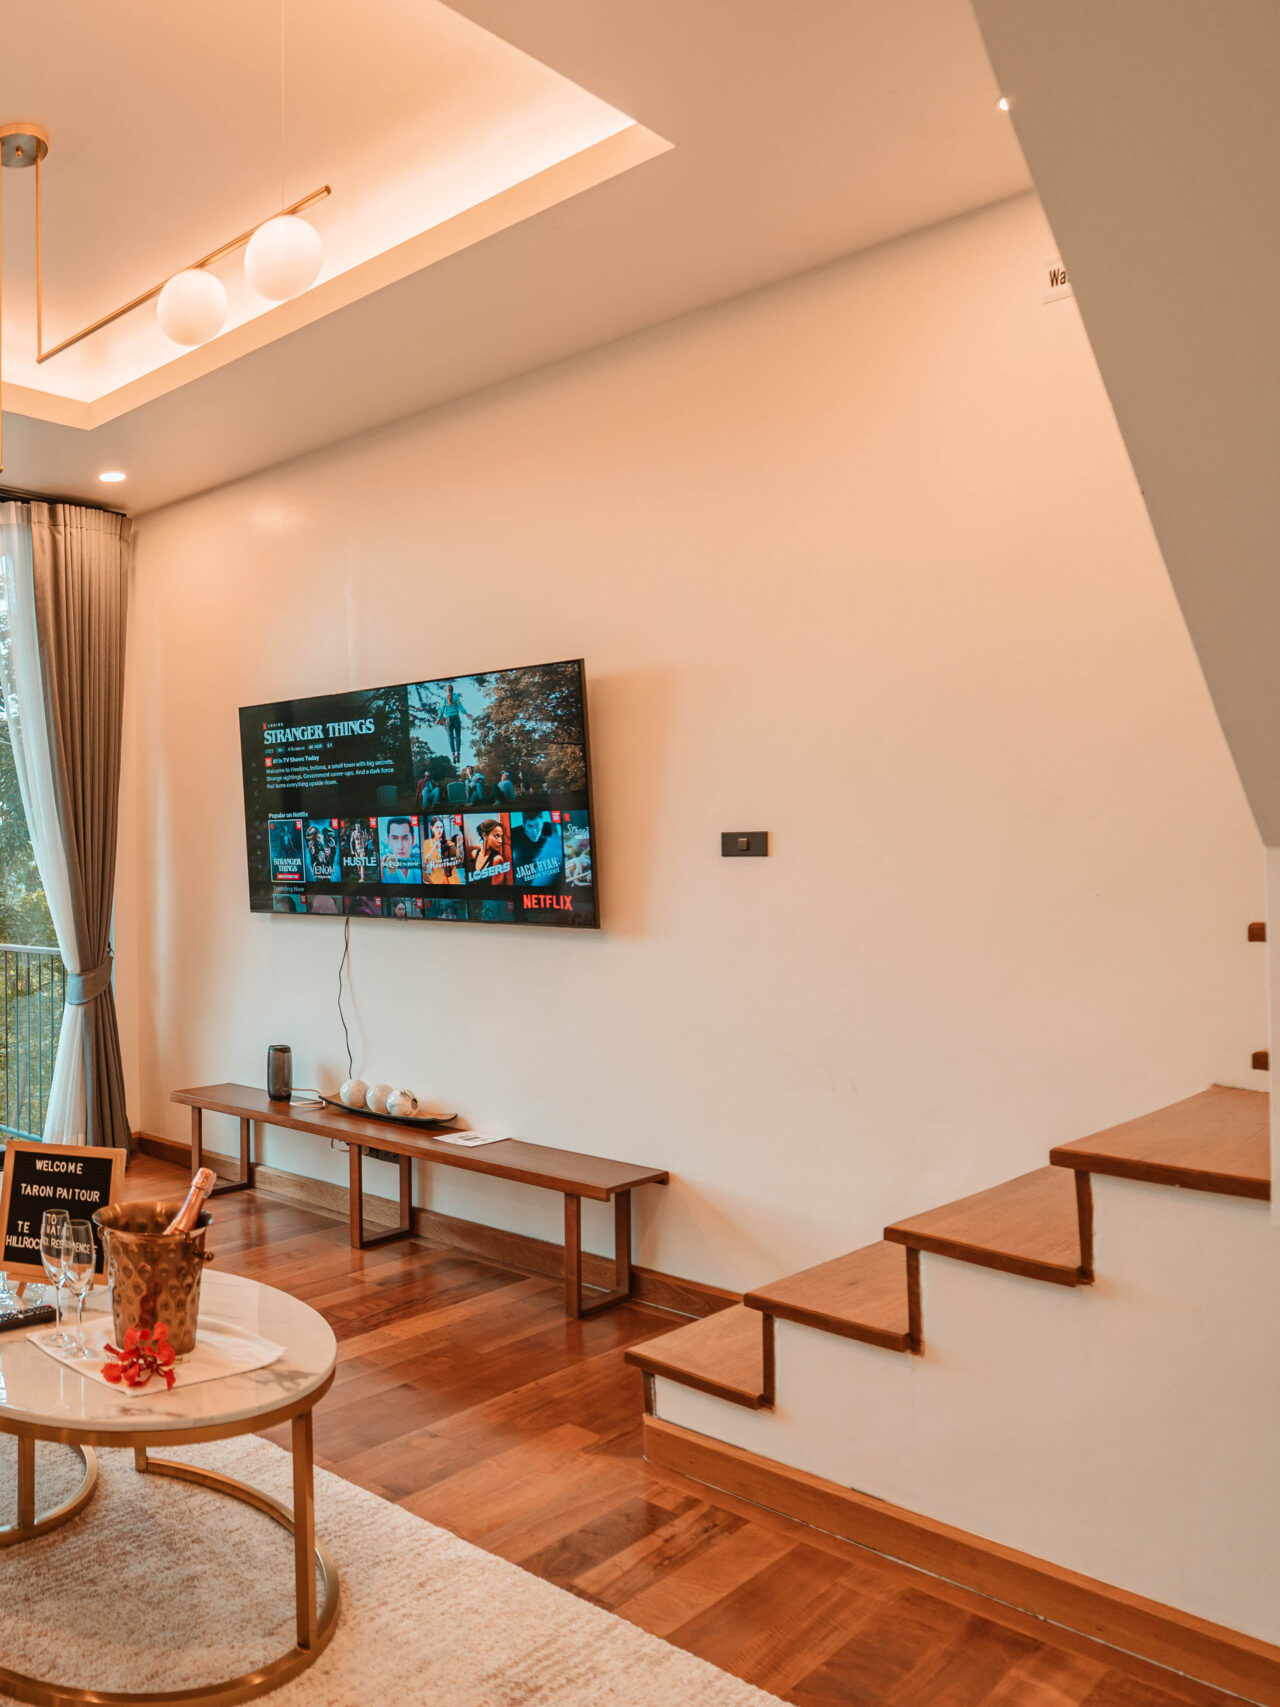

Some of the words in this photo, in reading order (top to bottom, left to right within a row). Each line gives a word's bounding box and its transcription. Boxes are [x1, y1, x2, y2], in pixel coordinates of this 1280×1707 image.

[264, 725, 324, 745] STRANGER
[327, 718, 375, 738] THINGS
[273, 858, 301, 866] STRANGER
[343, 856, 377, 867] HUSTLE
[310, 865, 335, 875] VENOM
[468, 861, 510, 882] LOSERS
[516, 862, 536, 878] JACK
[523, 894, 573, 911] NETFLIX
[35, 1159, 83, 1175] WELCOME
[20, 1183, 54, 1198] TARON
[74, 1188, 100, 1203] TOUR
